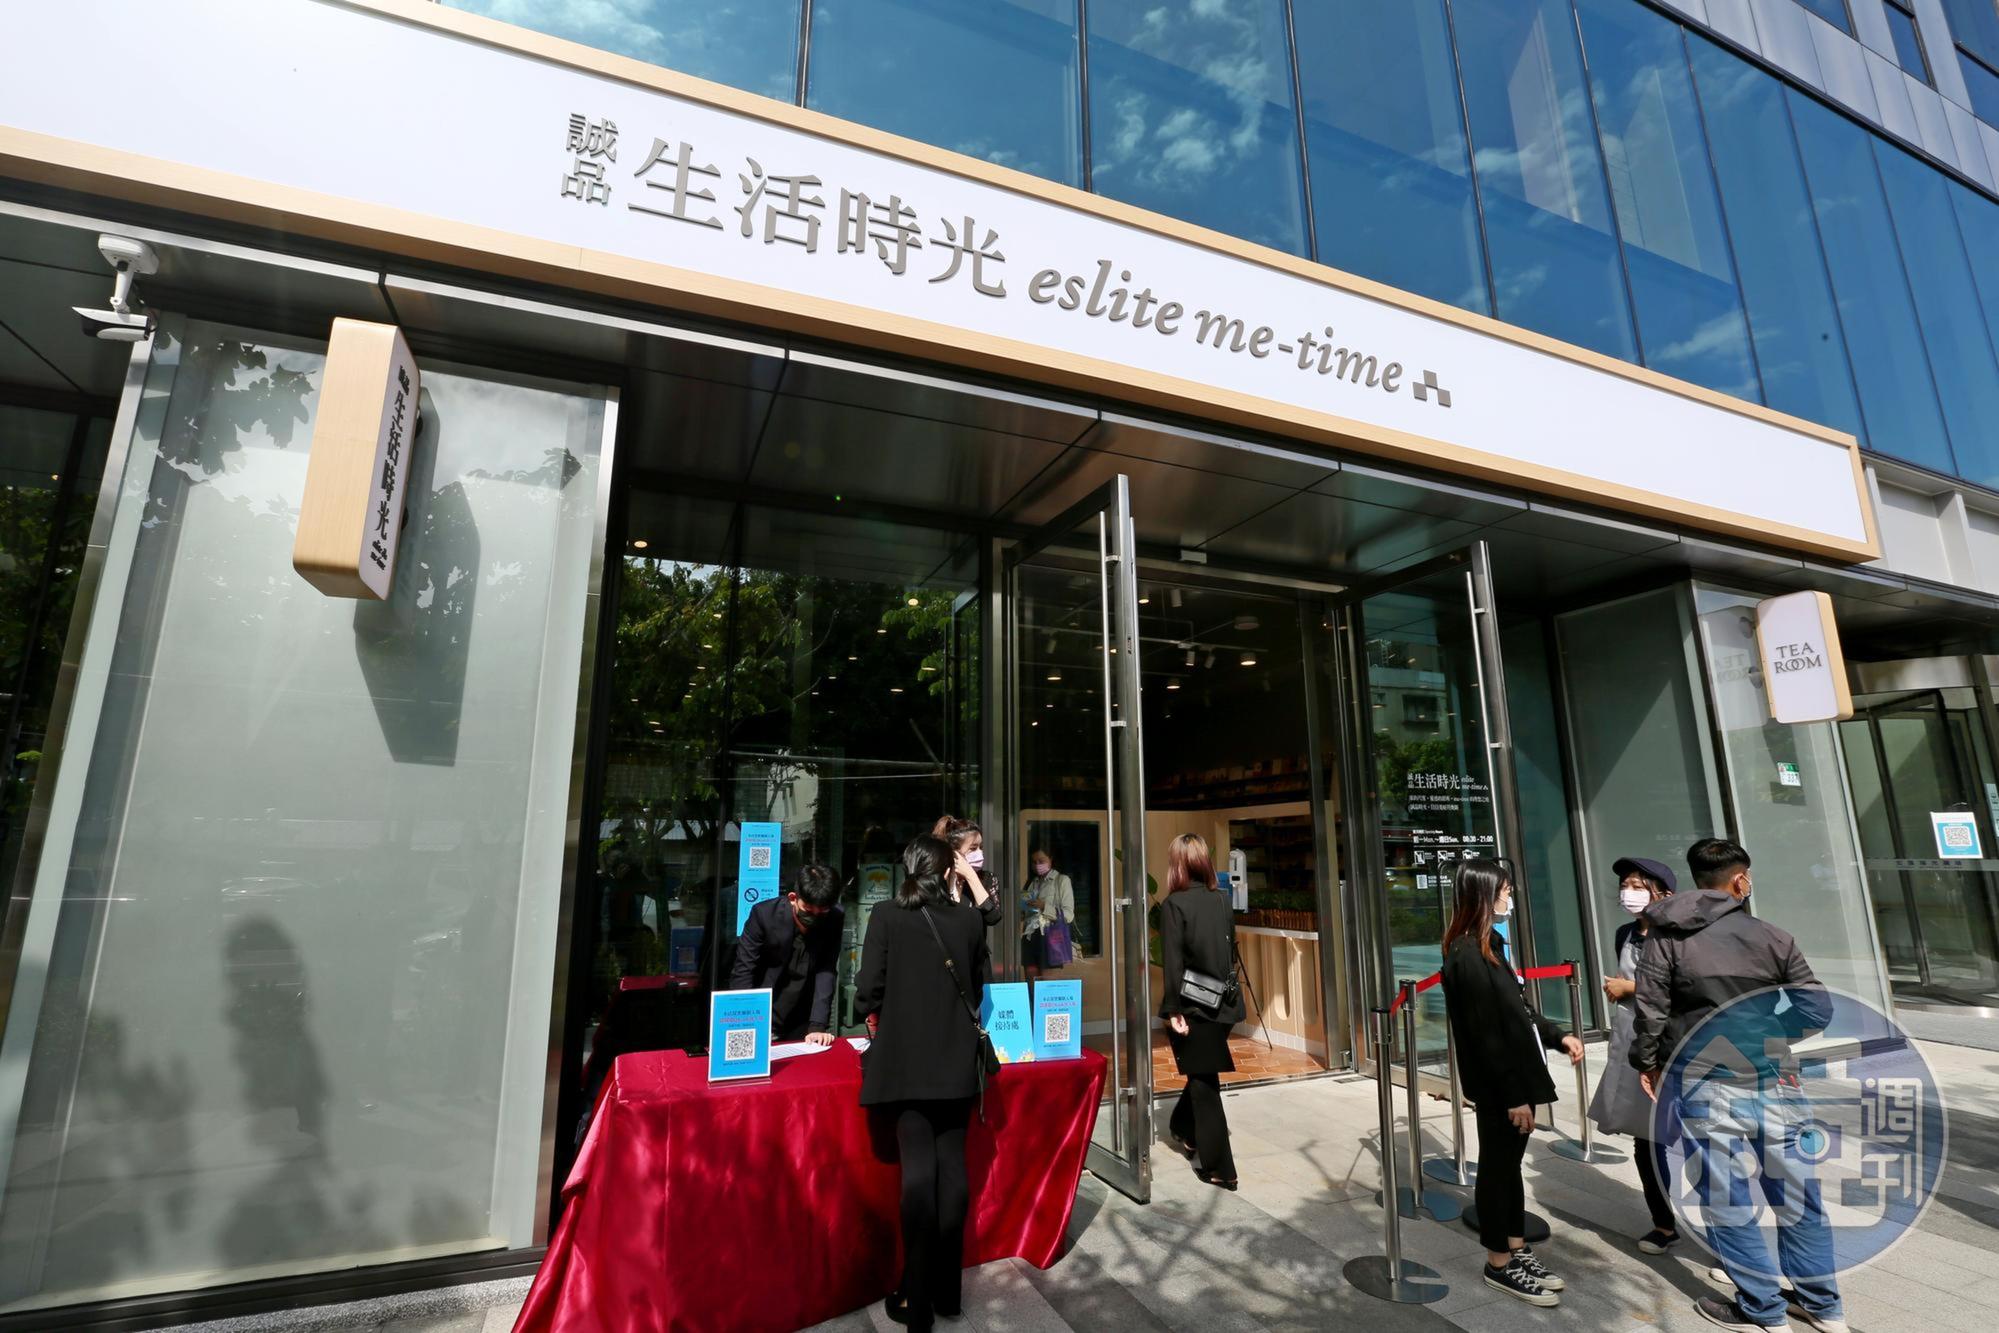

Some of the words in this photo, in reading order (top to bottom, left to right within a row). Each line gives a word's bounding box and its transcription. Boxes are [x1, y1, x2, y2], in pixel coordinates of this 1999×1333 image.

[561, 112, 620, 205] 誠品
[627, 136, 1008, 299] 生活時光
[1028, 259, 1184, 335] eslite
[1194, 309, 1404, 392] me-time
[375, 389, 406, 541] 生活時光
[1773, 654, 1822, 674] ROOM
[1775, 642, 1814, 659] TEA
[1414, 773, 1460, 790] 生活時光
